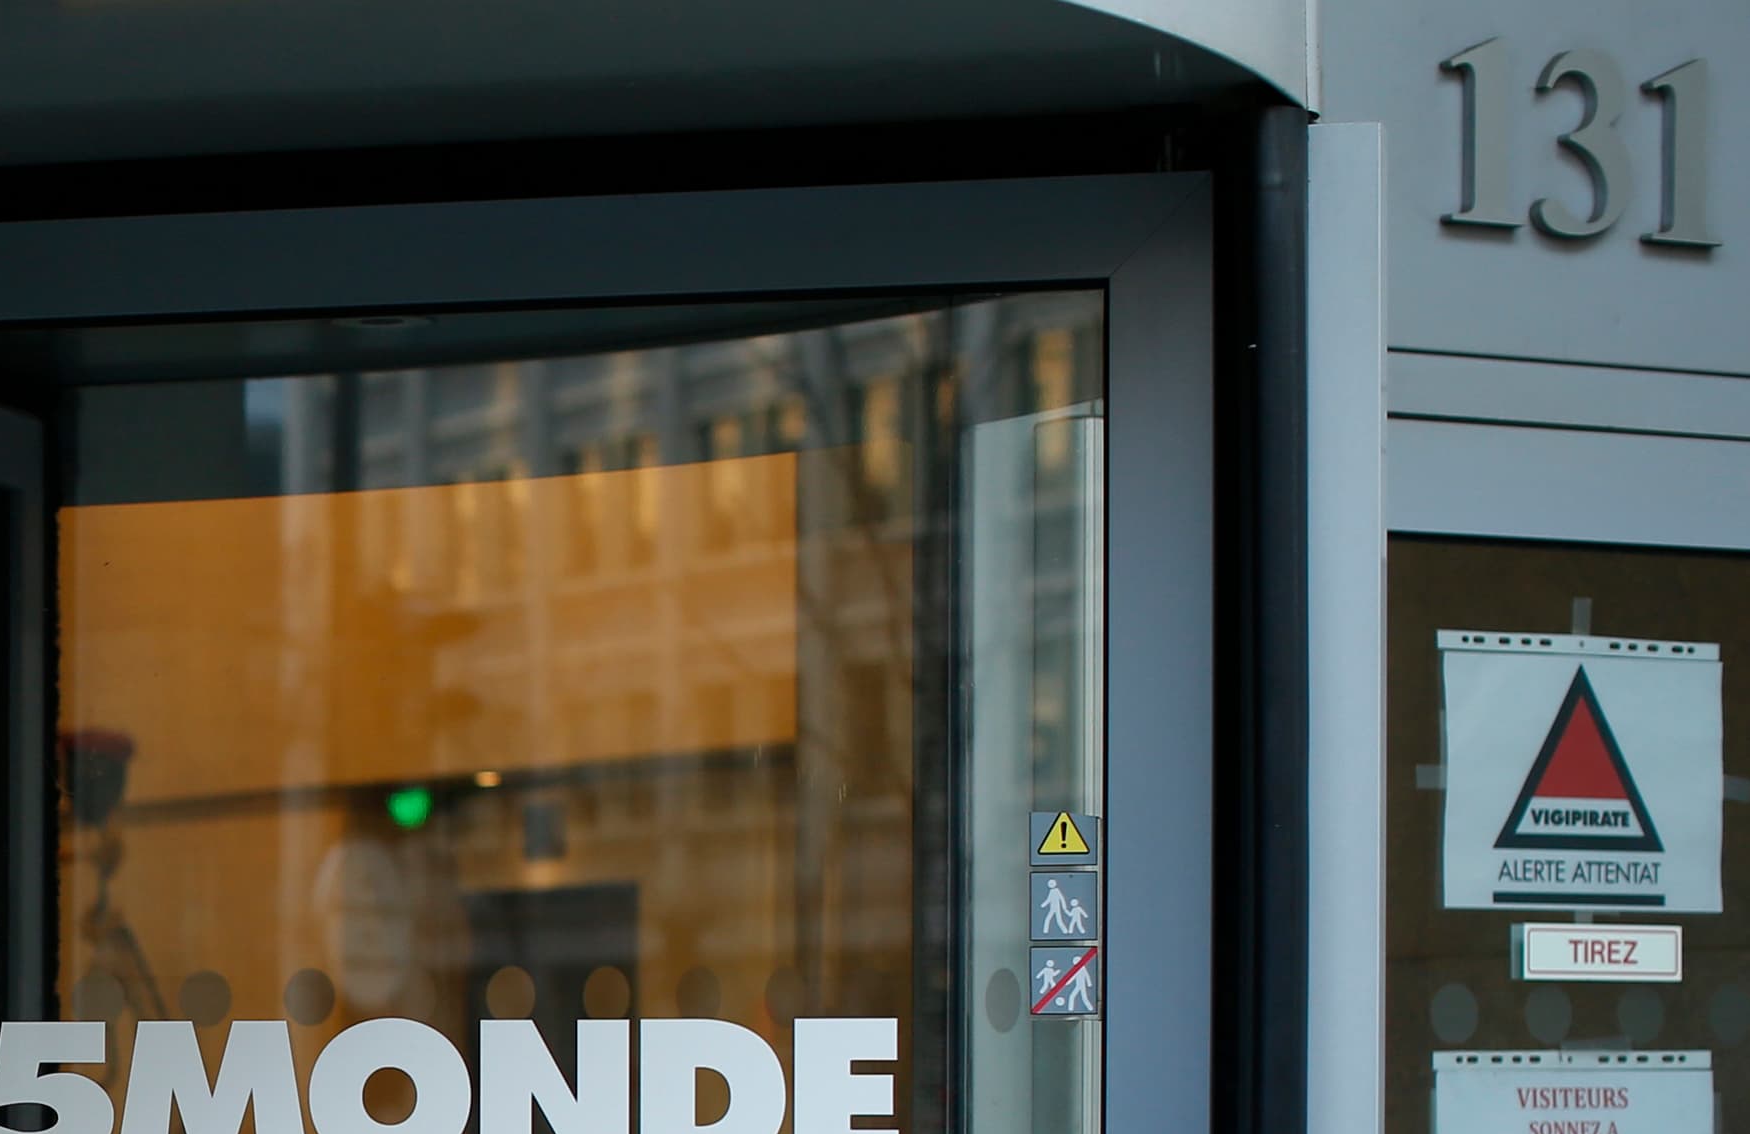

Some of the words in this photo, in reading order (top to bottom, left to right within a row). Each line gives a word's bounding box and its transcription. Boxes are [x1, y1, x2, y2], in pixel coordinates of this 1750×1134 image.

[1439, 36, 1723, 248] 131
[1531, 808, 1630, 828] VIGIPIRATE
[1498, 859, 1566, 883] ALERTE
[1571, 861, 1662, 885] ATTENTAT
[1568, 939, 1638, 965] TIREZ
[1516, 1087, 1629, 1109] VISITEURS
